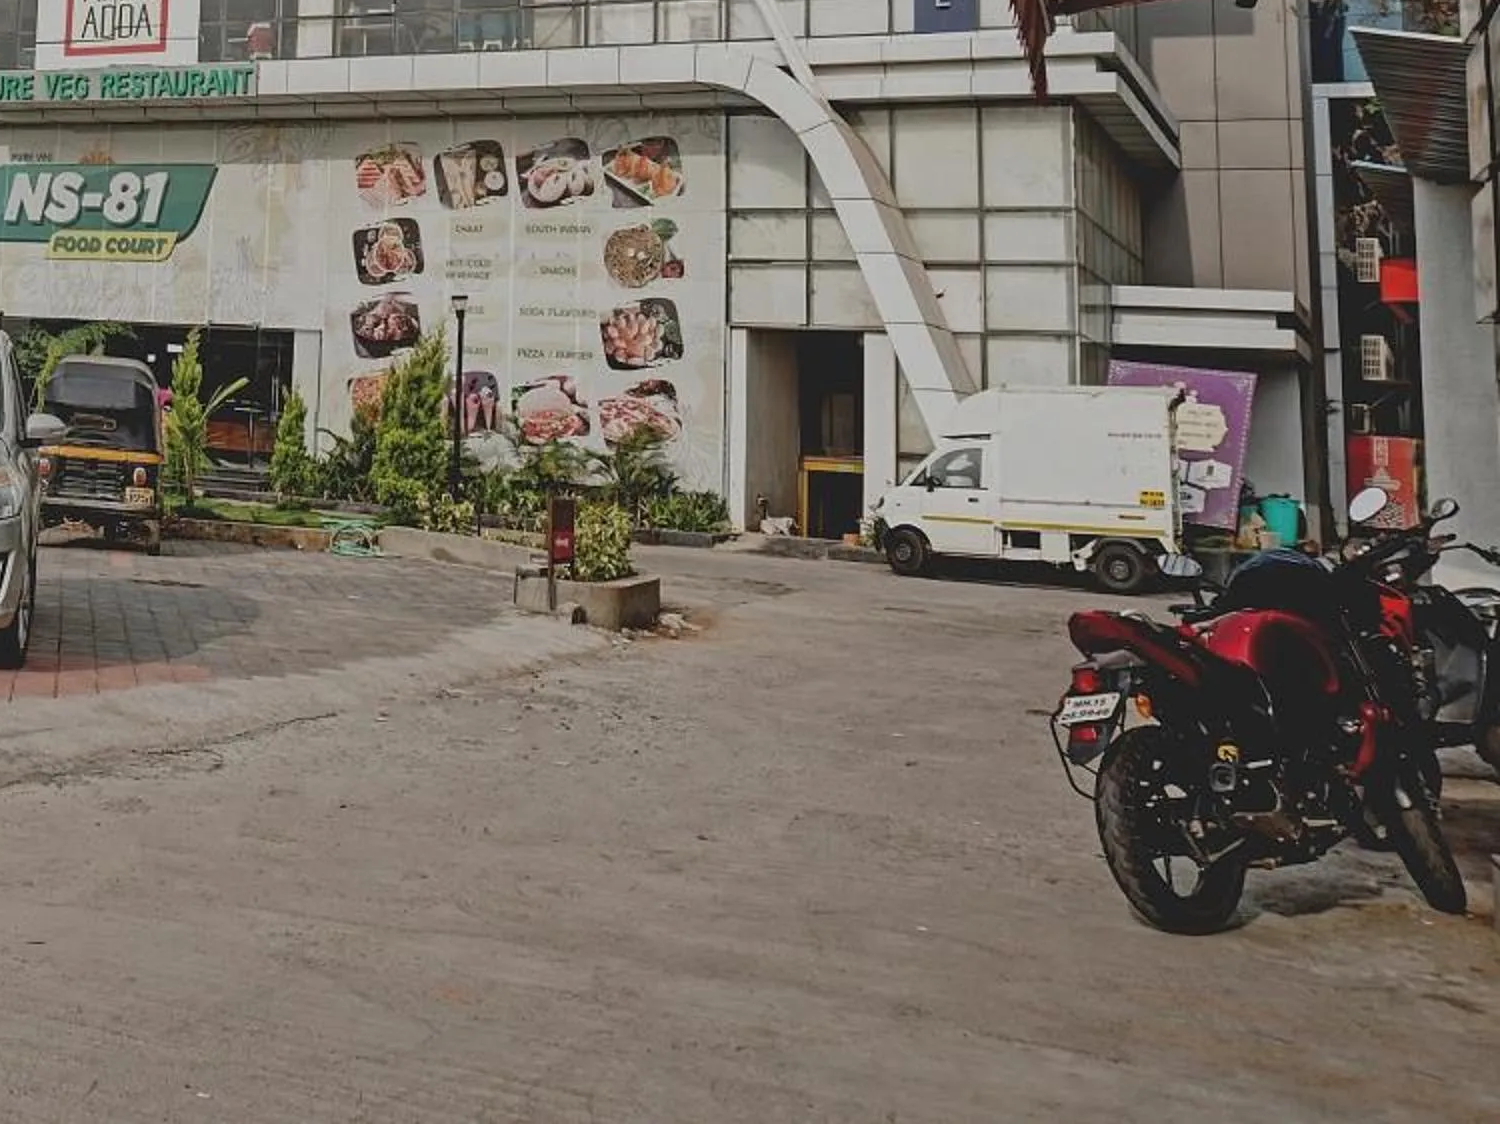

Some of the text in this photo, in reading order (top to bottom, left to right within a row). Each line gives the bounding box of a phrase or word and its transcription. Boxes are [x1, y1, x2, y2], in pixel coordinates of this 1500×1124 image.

[81, 2, 153, 41] ADDA
[42, 73, 90, 100] VEG
[99, 68, 254, 99] RESTAURANT
[3, 171, 170, 226] NS-81
[52, 236, 169, 255] FOOD COURT
